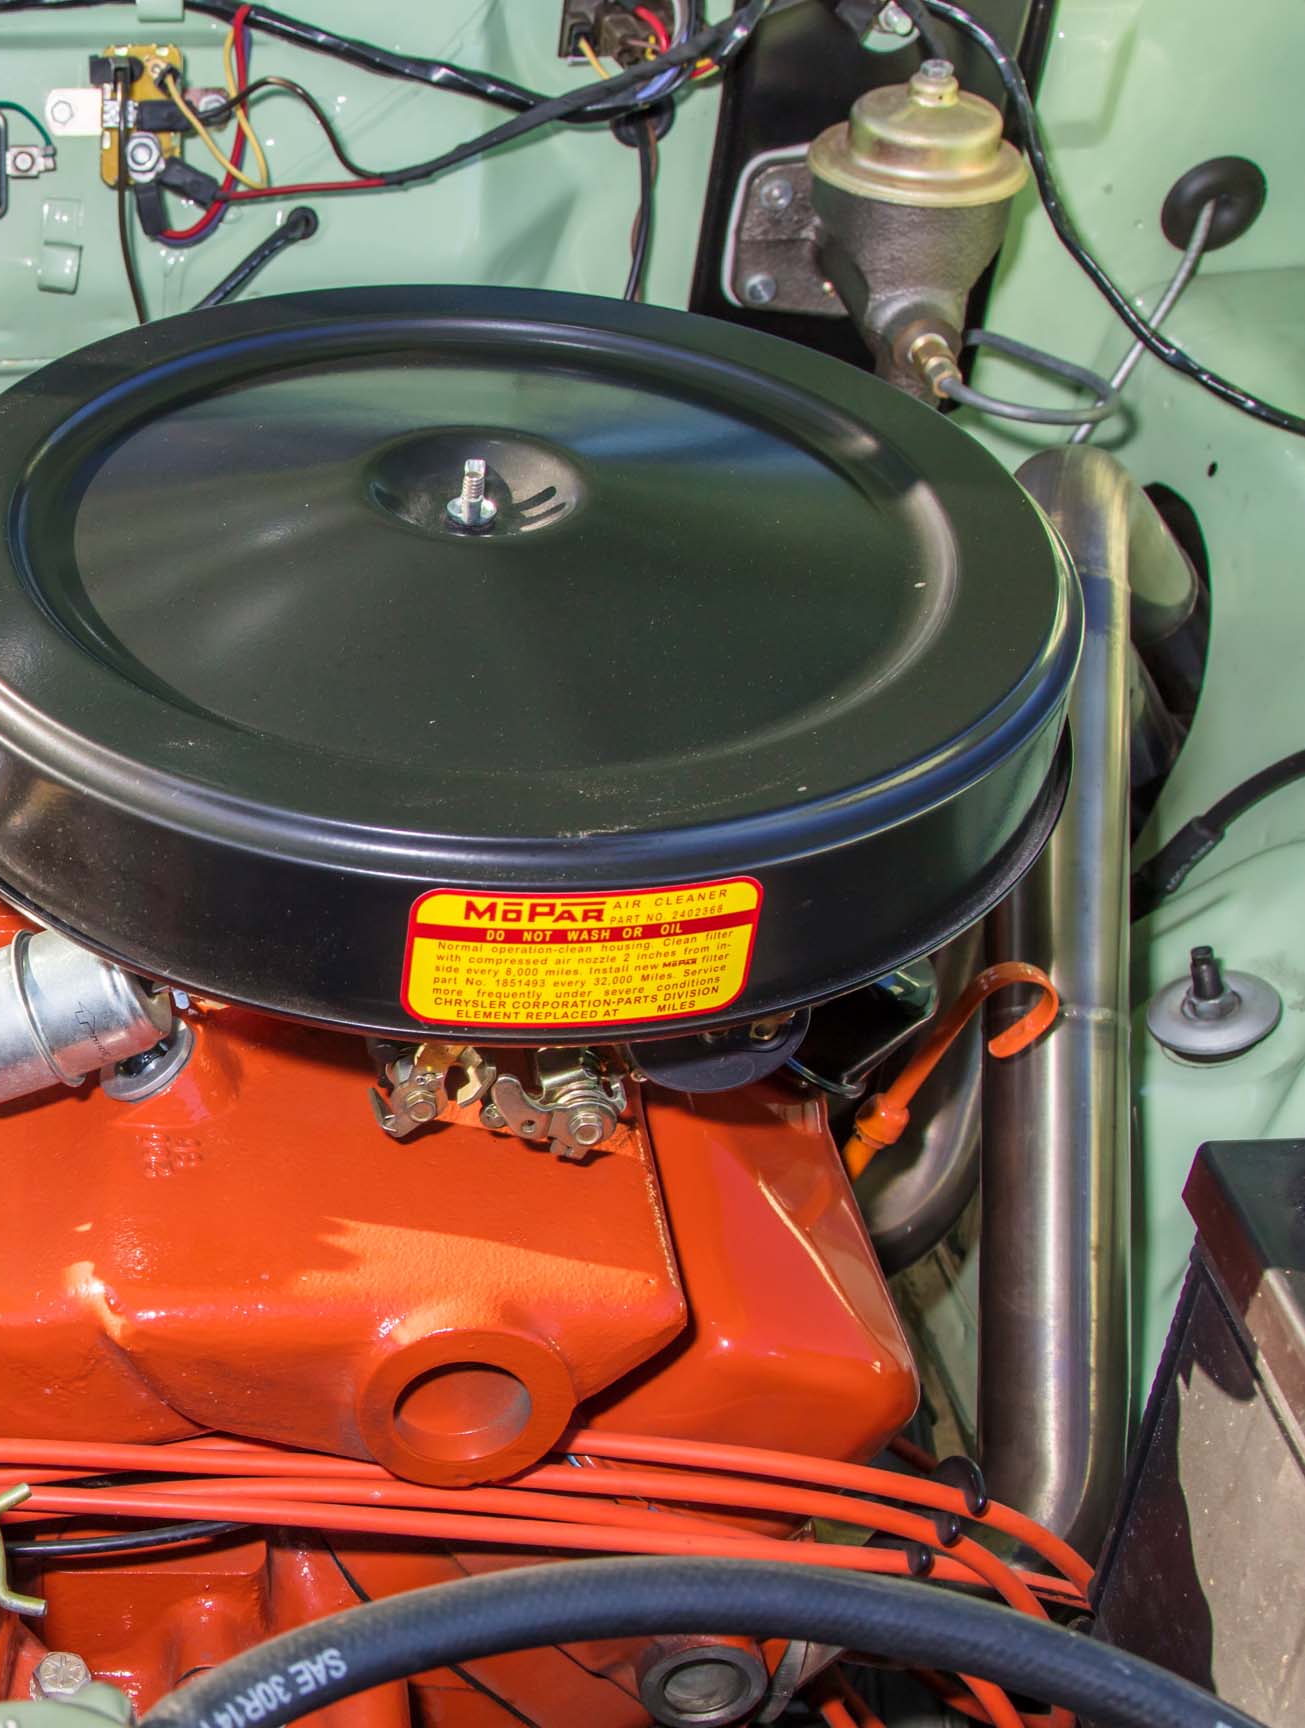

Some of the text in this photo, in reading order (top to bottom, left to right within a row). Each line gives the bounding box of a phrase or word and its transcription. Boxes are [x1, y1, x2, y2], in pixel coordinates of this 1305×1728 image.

[612, 889, 727, 910] AIR CLEANER
[610, 904, 724, 925] PART NO. 2402368
[438, 941, 483, 953] Normal
[491, 944, 592, 954] operation-clean
[663, 936, 697, 947] Clean
[705, 929, 734, 940] filter
[486, 923, 683, 942] DO NOT WASH OR OIL
[435, 965, 460, 974] side
[466, 967, 499, 978] every
[505, 967, 538, 977] 8,000
[545, 968, 582, 977] miles.
[589, 964, 629, 975] Install
[634, 963, 659, 972] new
[701, 952, 730, 963] filter
[436, 941, 732, 966] with compressed air nozzle 2 inches from in-
[432, 976, 720, 1000] more frequently under severe conditions
[433, 976, 457, 985] part
[465, 977, 487, 986] No.
[496, 979, 545, 988] 1851493
[553, 979, 585, 989] every
[593, 975, 633, 986] 32,000
[683, 964, 727, 978] Service
[434, 997, 507, 1009] CHRYSLER
[663, 985, 719, 1001] DIVISION
[456, 1000, 696, 1020] ELEMENT REPLACED AT MILES
[288, 1648, 347, 1696] SAE
